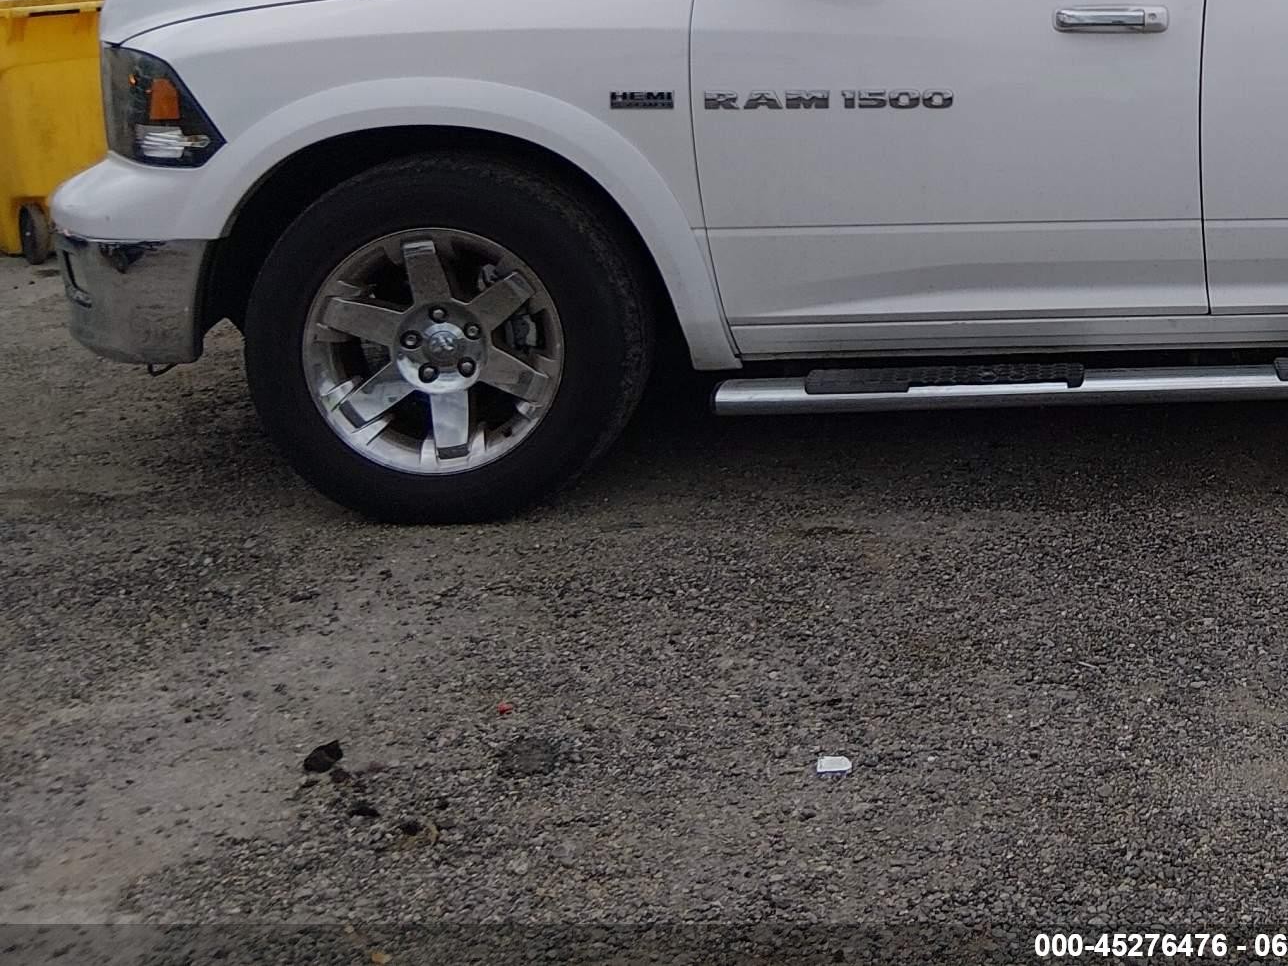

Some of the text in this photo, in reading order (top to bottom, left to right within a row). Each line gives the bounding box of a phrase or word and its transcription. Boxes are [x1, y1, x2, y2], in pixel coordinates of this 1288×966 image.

[610, 91, 673, 100] HEMI
[704, 89, 953, 110] RAM 1500
